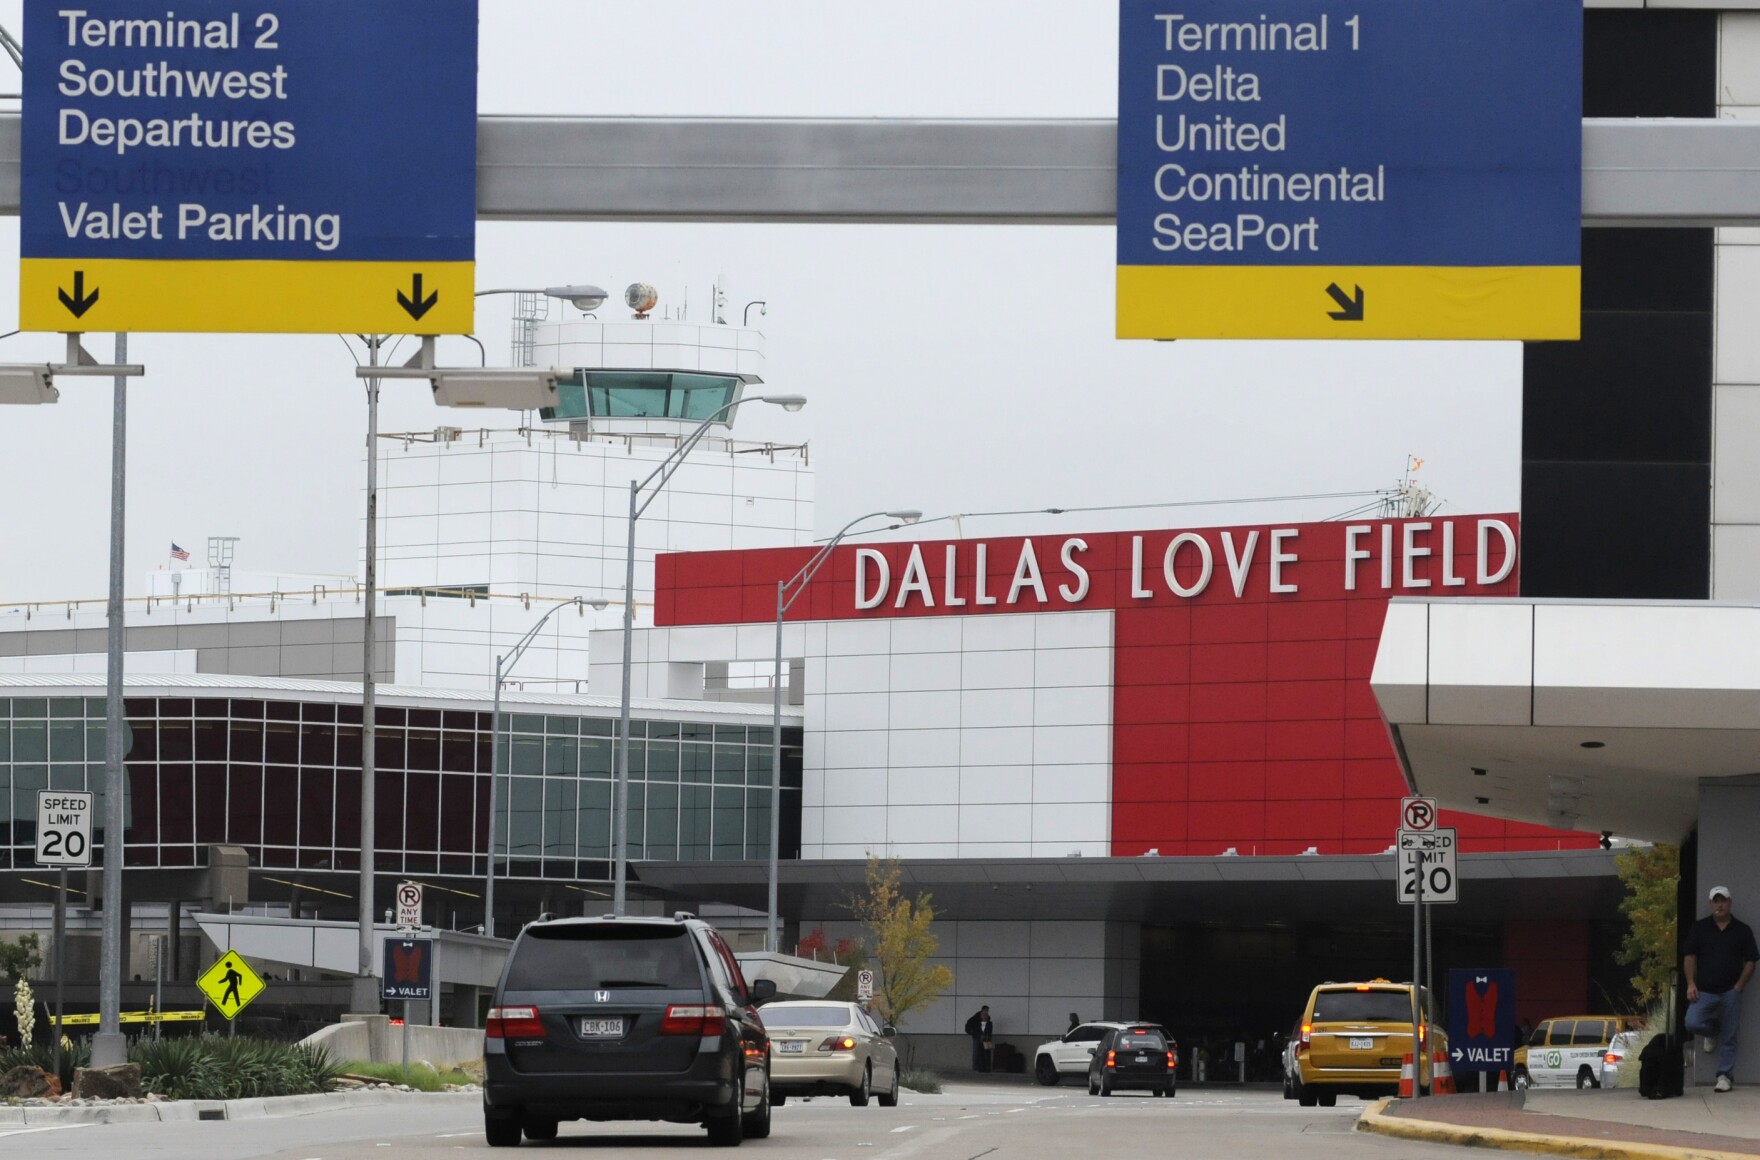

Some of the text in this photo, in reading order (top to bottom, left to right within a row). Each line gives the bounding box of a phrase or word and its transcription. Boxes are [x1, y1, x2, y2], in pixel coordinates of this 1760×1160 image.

[58, 10, 279, 49] Terminal 2
[1154, 14, 1359, 51] Terminal 1
[58, 59, 288, 99] Southwest
[1156, 64, 1261, 101] Delta
[58, 109, 296, 155] Departures
[1156, 114, 1286, 151] United
[1154, 163, 1384, 201] Continental
[58, 202, 340, 251] Valet Parking
[1152, 213, 1319, 251] SeaPort
[855, 518, 1517, 610] DALLAS LOVE FIELD
[44, 798, 87, 811] SPEED
[48, 813, 81, 826] LIMIT
[42, 830, 85, 858] 20
[1408, 851, 1446, 864] LMIT
[1404, 866, 1452, 895] 20
[400, 908, 418, 916] ANY
[400, 916, 418, 925] TIME
[399, 987, 428, 996] VALET
[584, 1021, 621, 1032] CBK-106
[1467, 1047, 1511, 1062] VALET
[1547, 1052, 1560, 1066] GO
